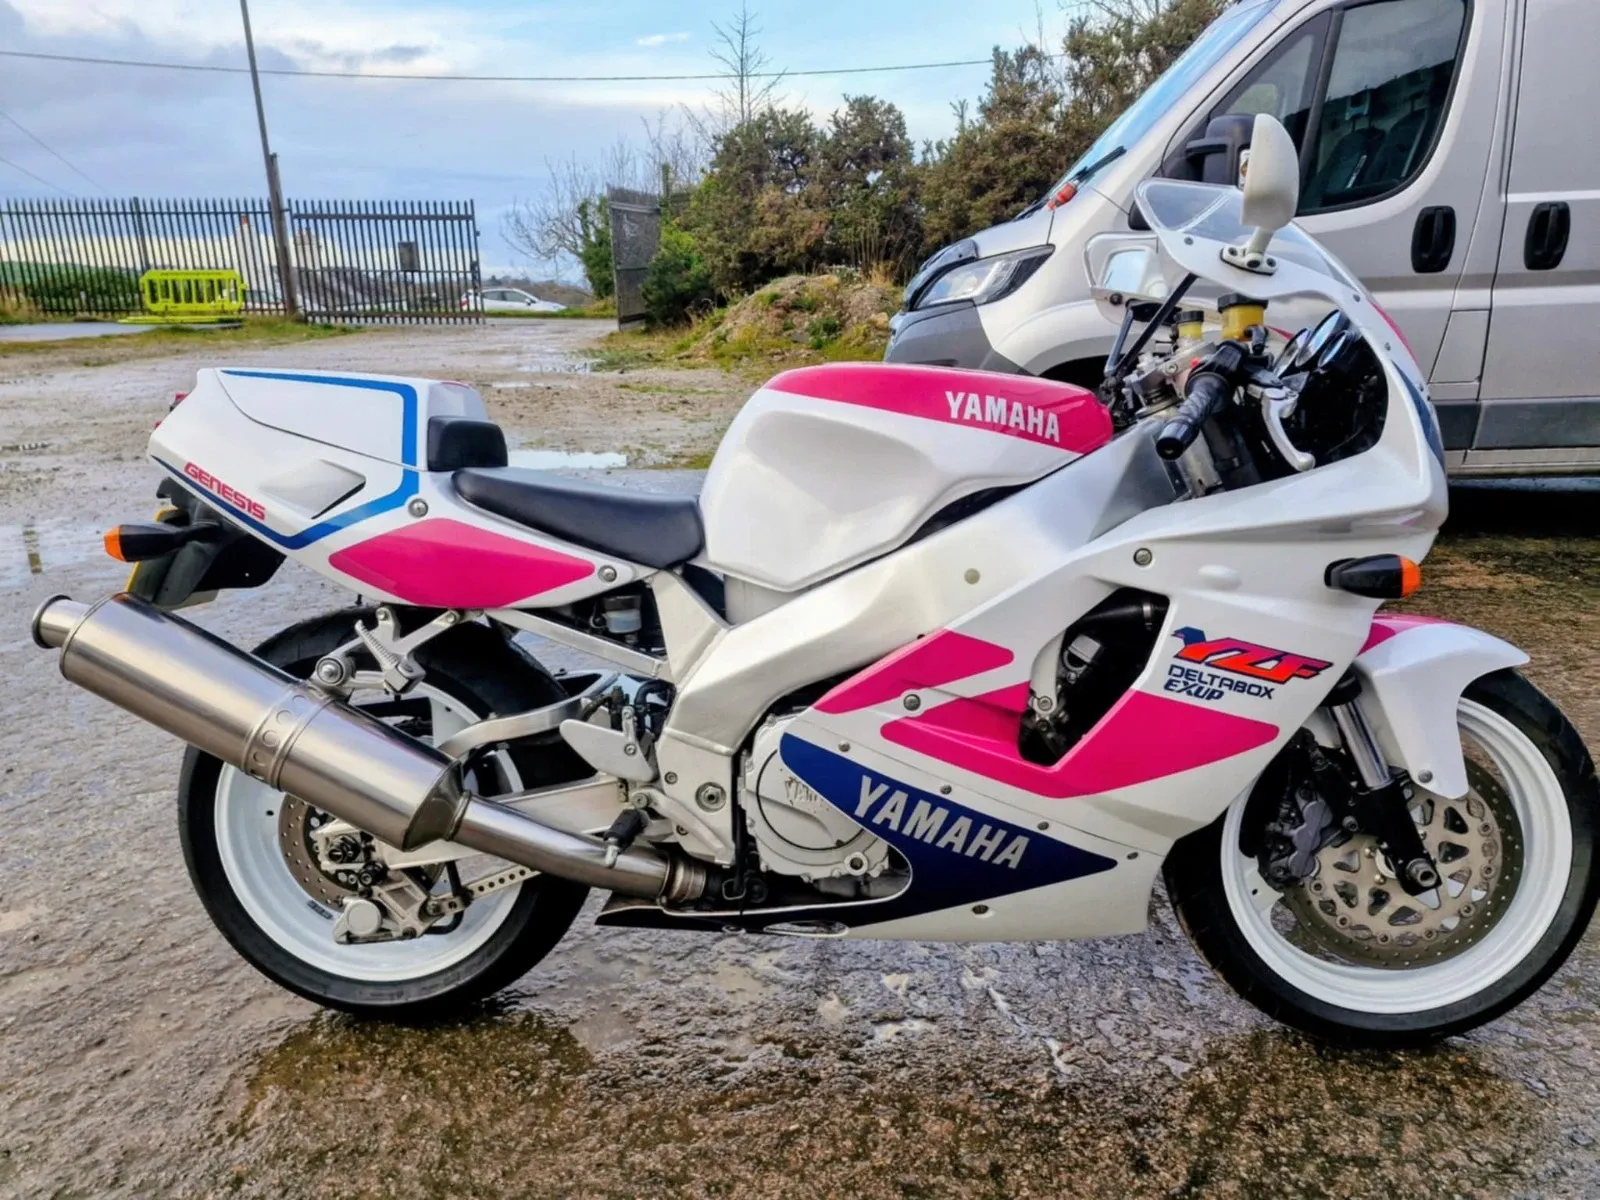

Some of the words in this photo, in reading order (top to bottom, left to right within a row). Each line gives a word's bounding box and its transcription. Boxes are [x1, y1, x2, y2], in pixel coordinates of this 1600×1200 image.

[945, 391, 1060, 443] YAMAHA
[184, 462, 266, 520] GENESIS
[1168, 664, 1275, 700] DELTABOX
[1171, 626, 1334, 684] YZF
[1163, 679, 1224, 701] EXUP
[854, 774, 1030, 870] YAMAHA
